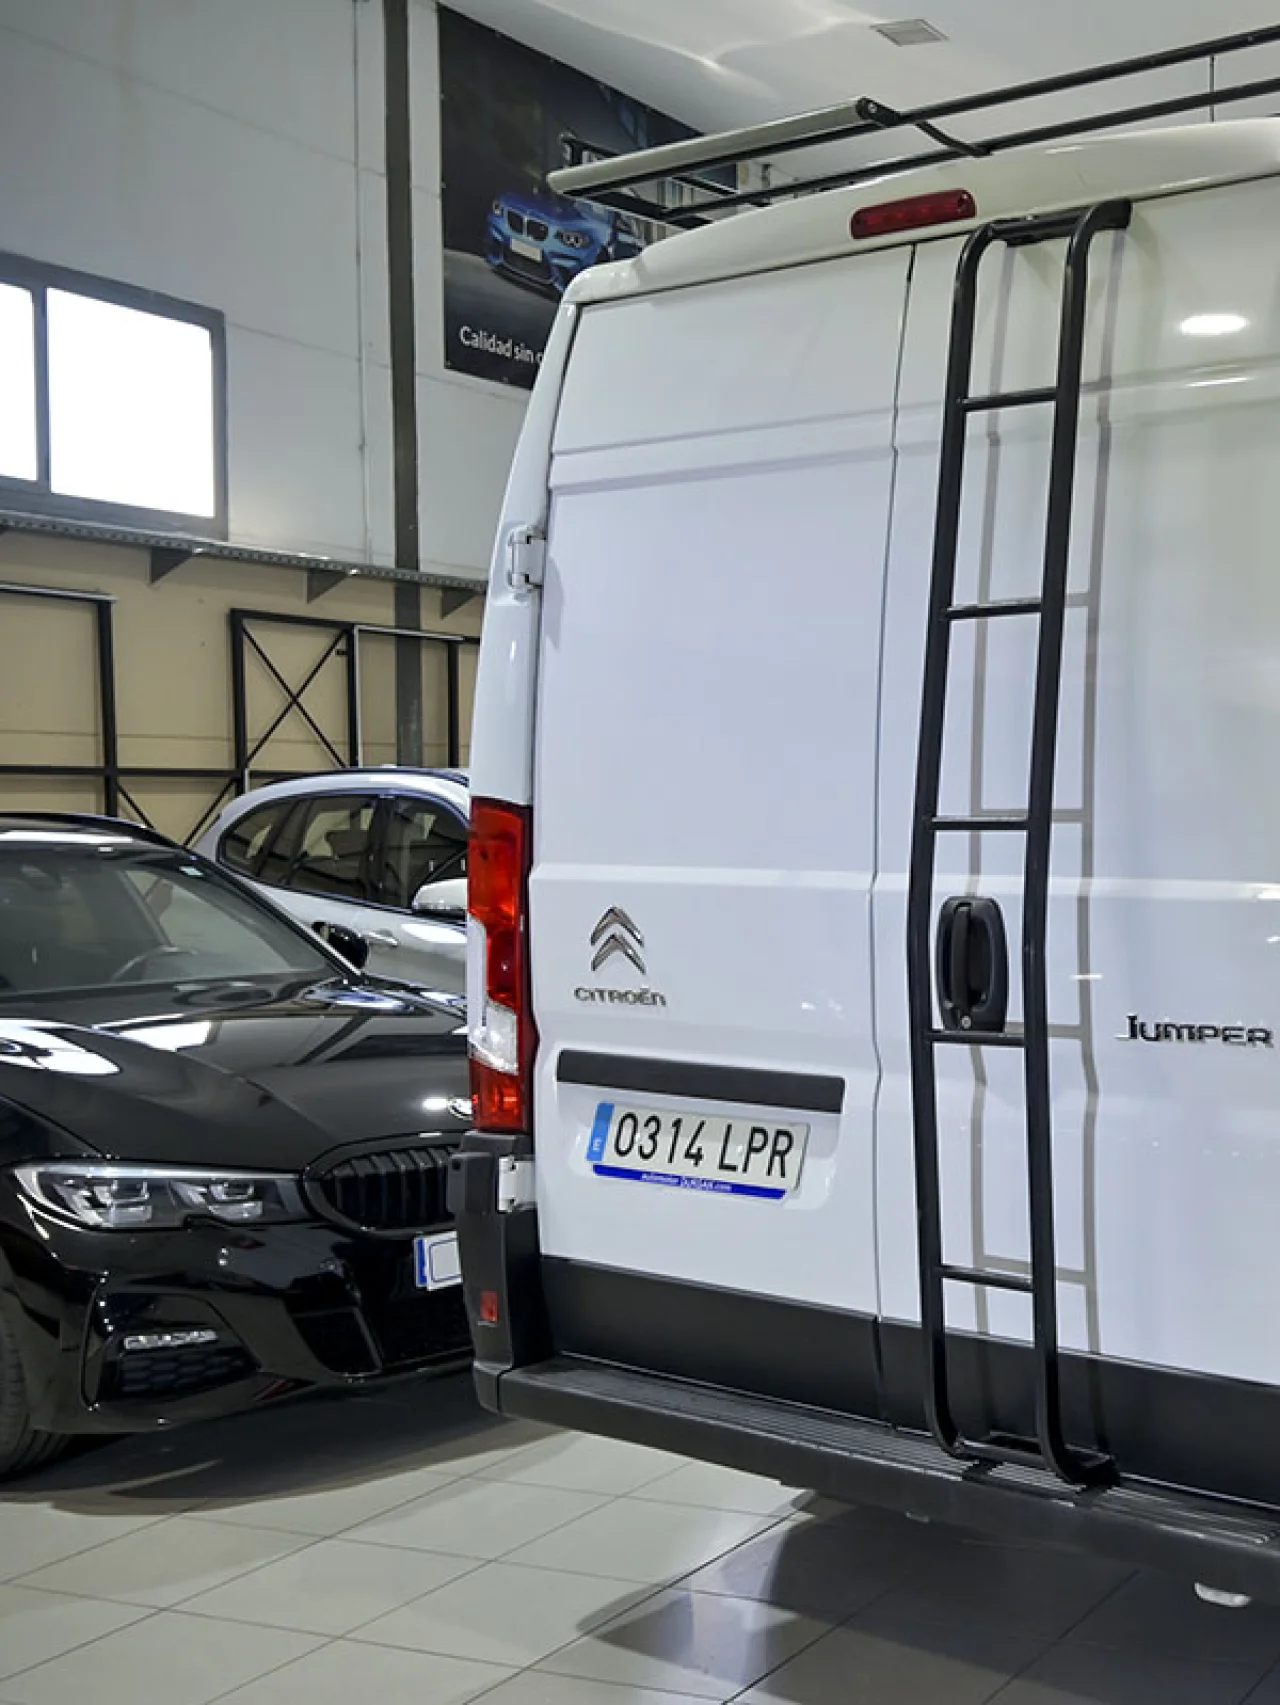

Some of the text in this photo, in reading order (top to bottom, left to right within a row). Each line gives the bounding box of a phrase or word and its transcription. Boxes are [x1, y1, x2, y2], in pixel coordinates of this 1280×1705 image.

[459, 325, 513, 357] Calidad
[514, 343, 534, 363] sin
[613, 1112, 794, 1178] 0314 LPR
